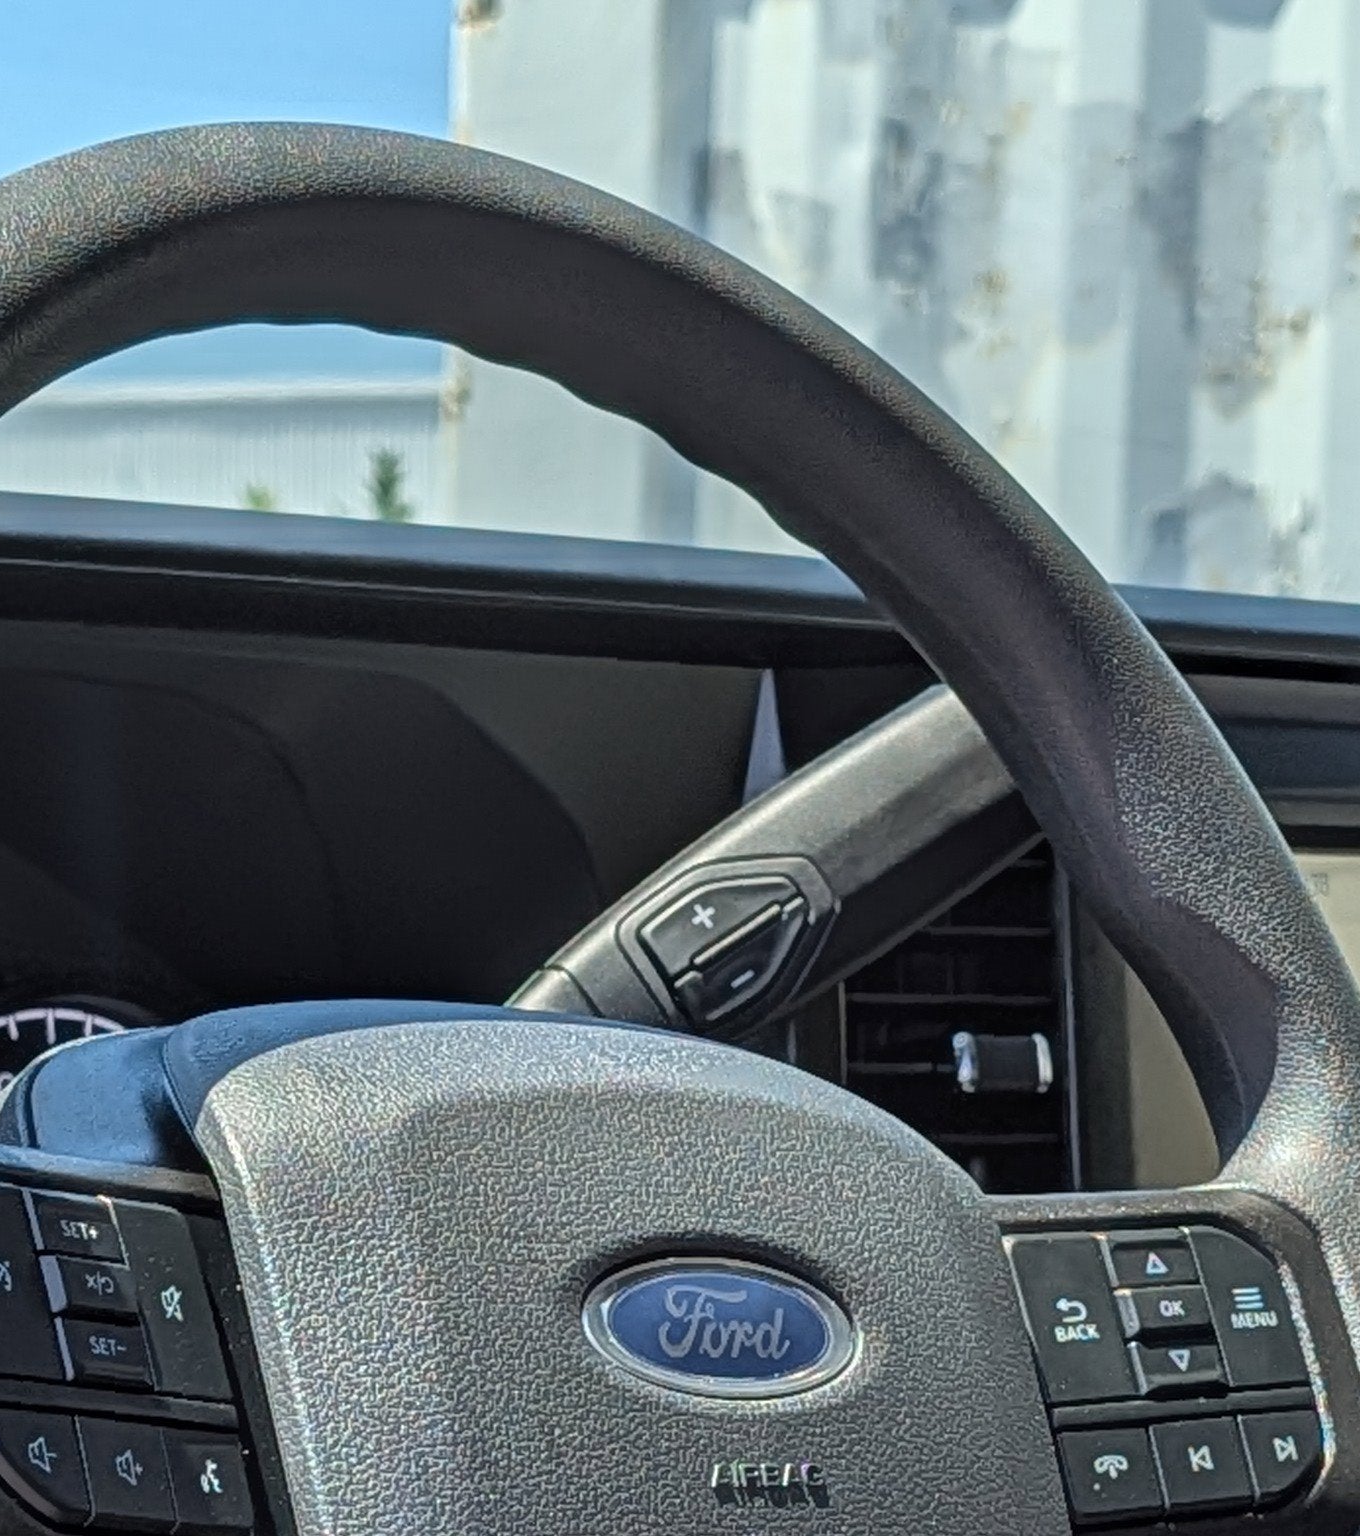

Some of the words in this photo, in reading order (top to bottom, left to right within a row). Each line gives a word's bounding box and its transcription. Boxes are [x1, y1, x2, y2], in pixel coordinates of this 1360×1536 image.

[60, 1221, 99, 1240] SET+
[1158, 1299, 1185, 1317] OK
[659, 1284, 791, 1360] Ford
[1231, 1311, 1278, 1329] MENU
[1054, 1323, 1101, 1343] BACK
